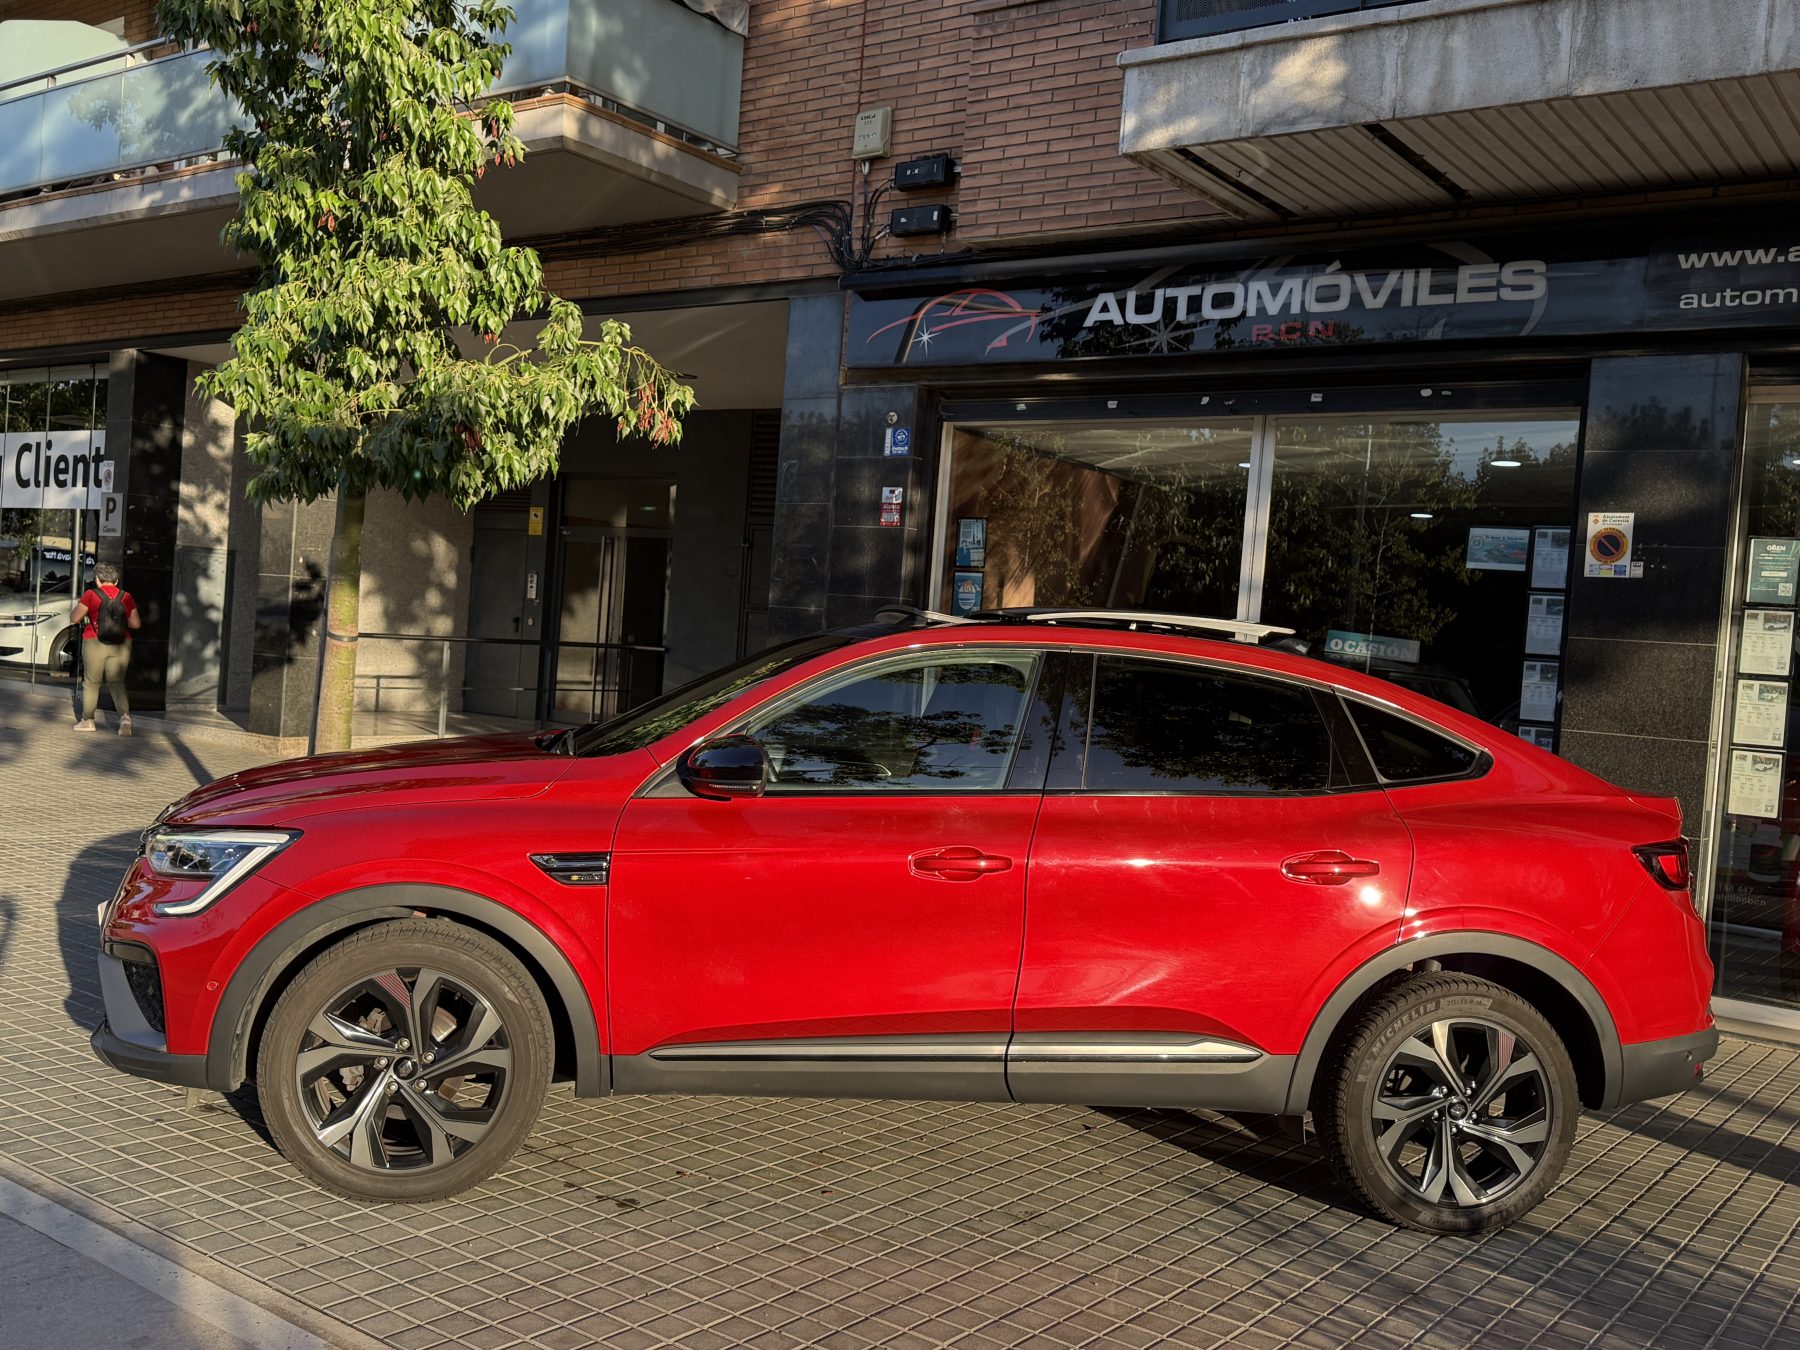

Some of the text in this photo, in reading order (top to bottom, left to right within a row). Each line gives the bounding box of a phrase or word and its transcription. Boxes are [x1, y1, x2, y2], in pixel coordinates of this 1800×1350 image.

[1677, 244, 1800, 269] www.a
[1083, 259, 1547, 328] AUTOMÓVILES
[1679, 287, 1798, 309] autom
[1250, 320, 1335, 342] BCN
[15, 439, 104, 489] Client
[105, 496, 117, 522] P
[1329, 638, 1418, 660] OCASIÓN
[1371, 1001, 1436, 1057] MICHELIN
